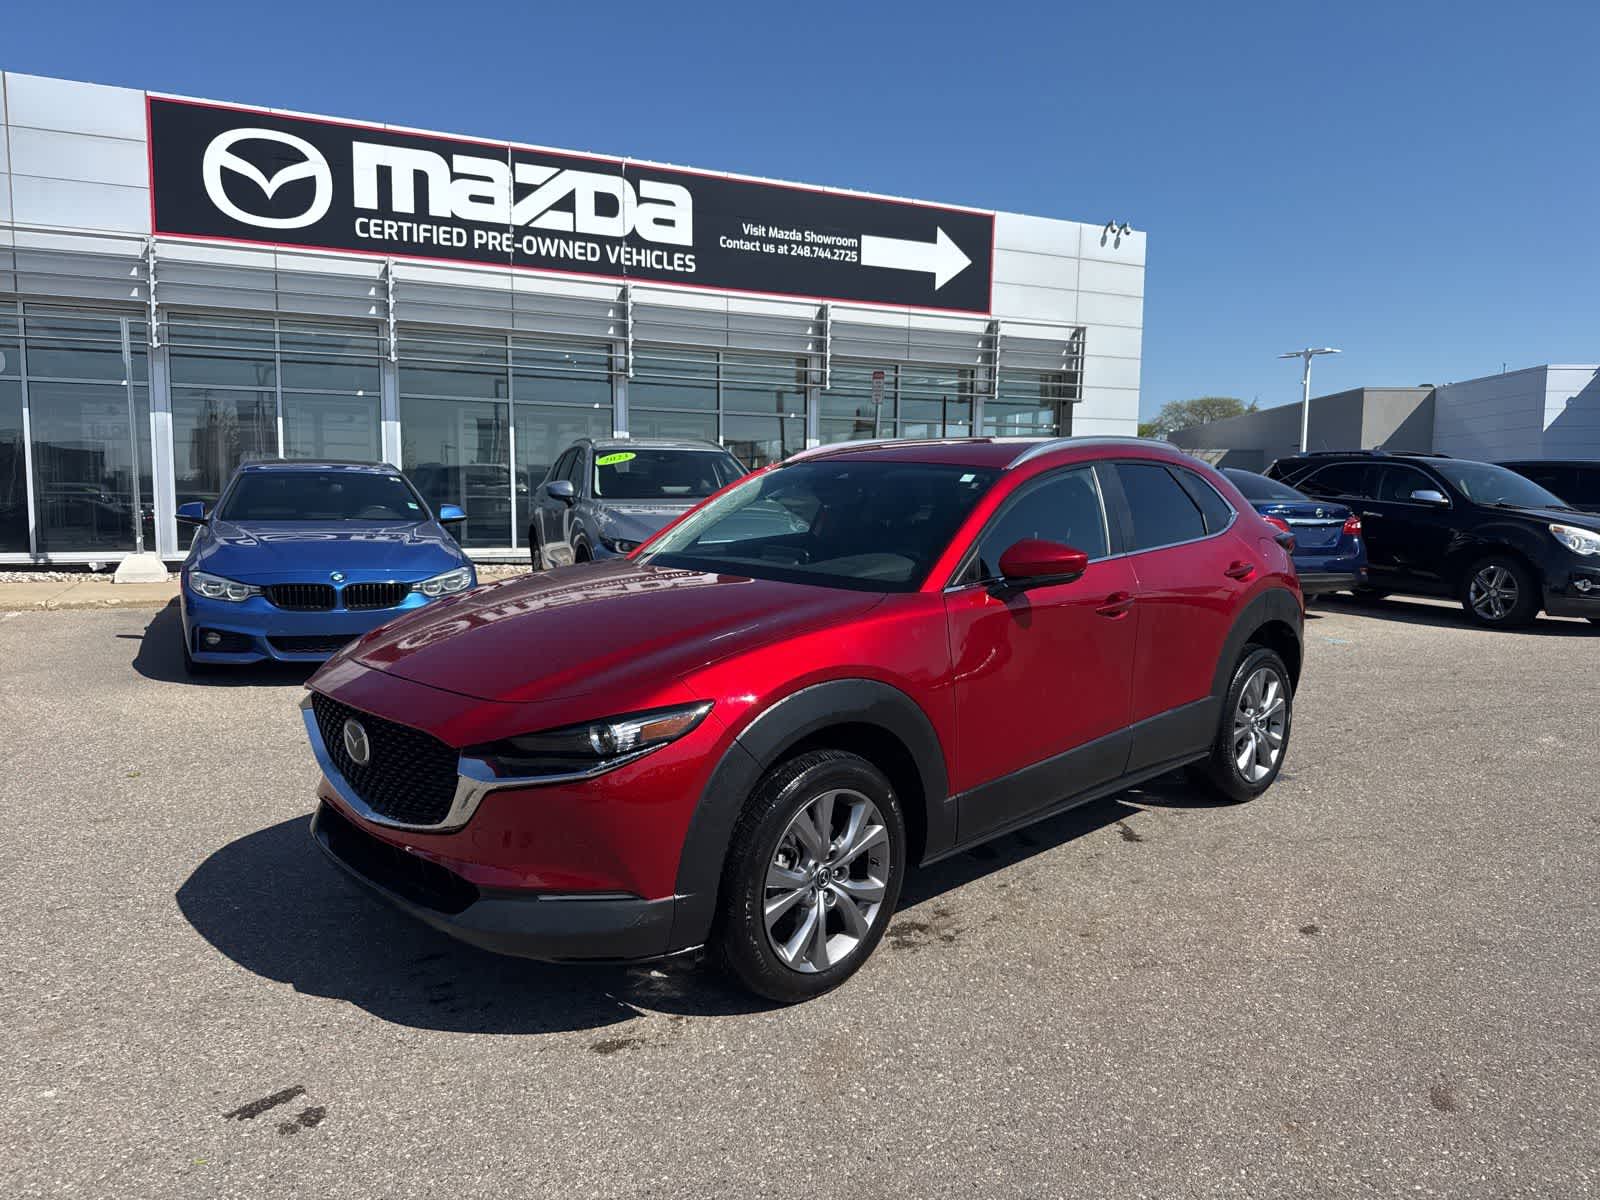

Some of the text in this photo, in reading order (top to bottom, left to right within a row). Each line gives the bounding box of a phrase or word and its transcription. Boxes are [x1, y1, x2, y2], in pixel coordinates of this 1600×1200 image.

[354, 216, 697, 273] CERTIFIED PRE-OWNED VEHICLES
[742, 223, 858, 247] Visit Mazda Showroom
[719, 236, 858, 262] Contact us at 248.744.2725
